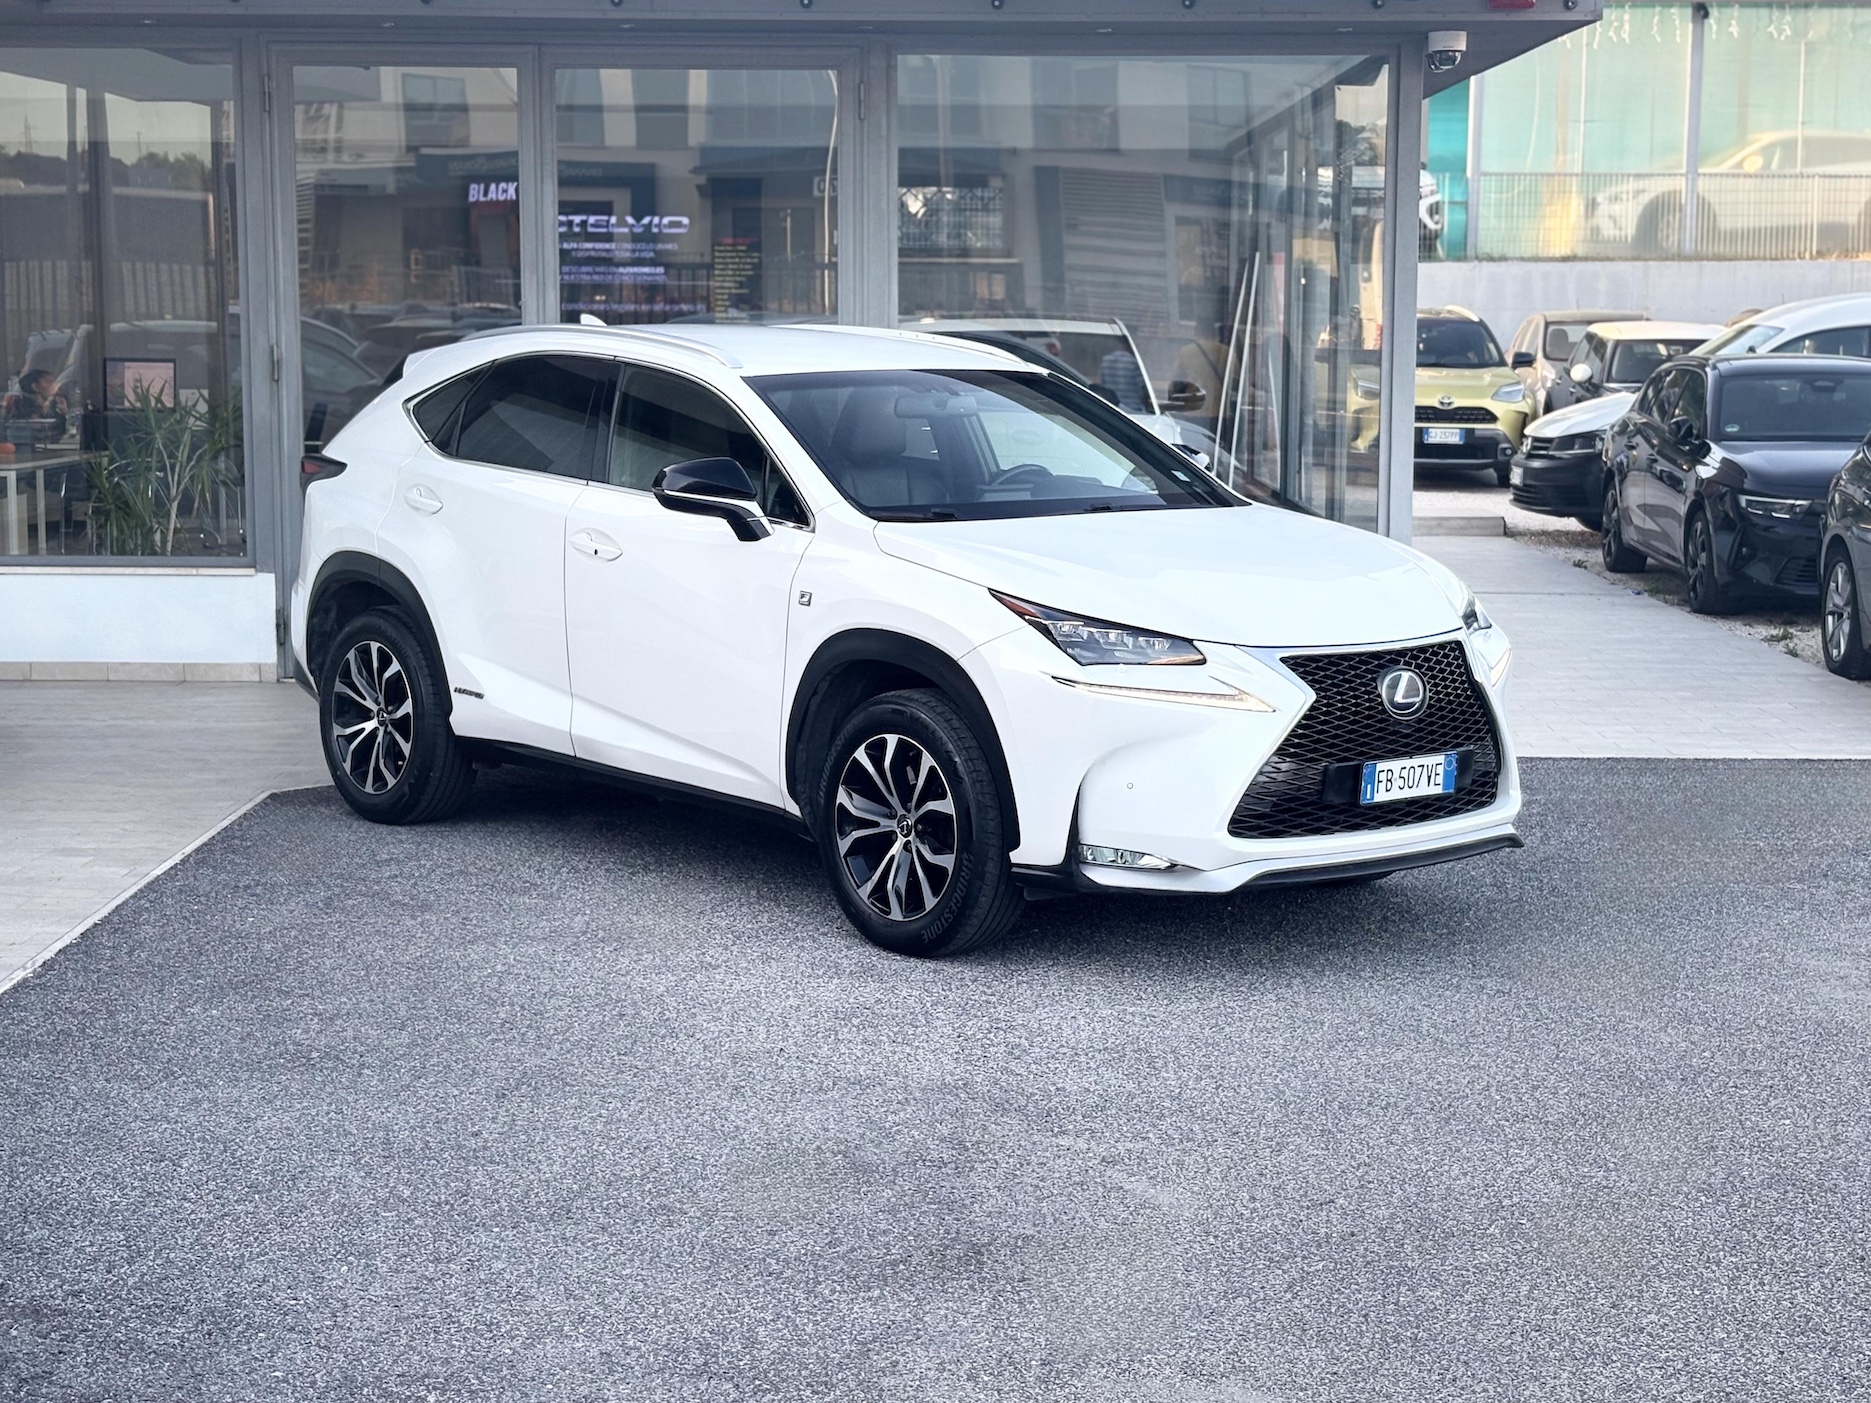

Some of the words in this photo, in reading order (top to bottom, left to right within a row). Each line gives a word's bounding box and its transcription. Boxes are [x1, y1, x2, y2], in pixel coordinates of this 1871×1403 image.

[468, 181, 518, 202] BLACK
[1376, 769, 1394, 794] FB
[1398, 763, 1443, 790] 507VE
[921, 850, 974, 943] BRIDGESTONE
